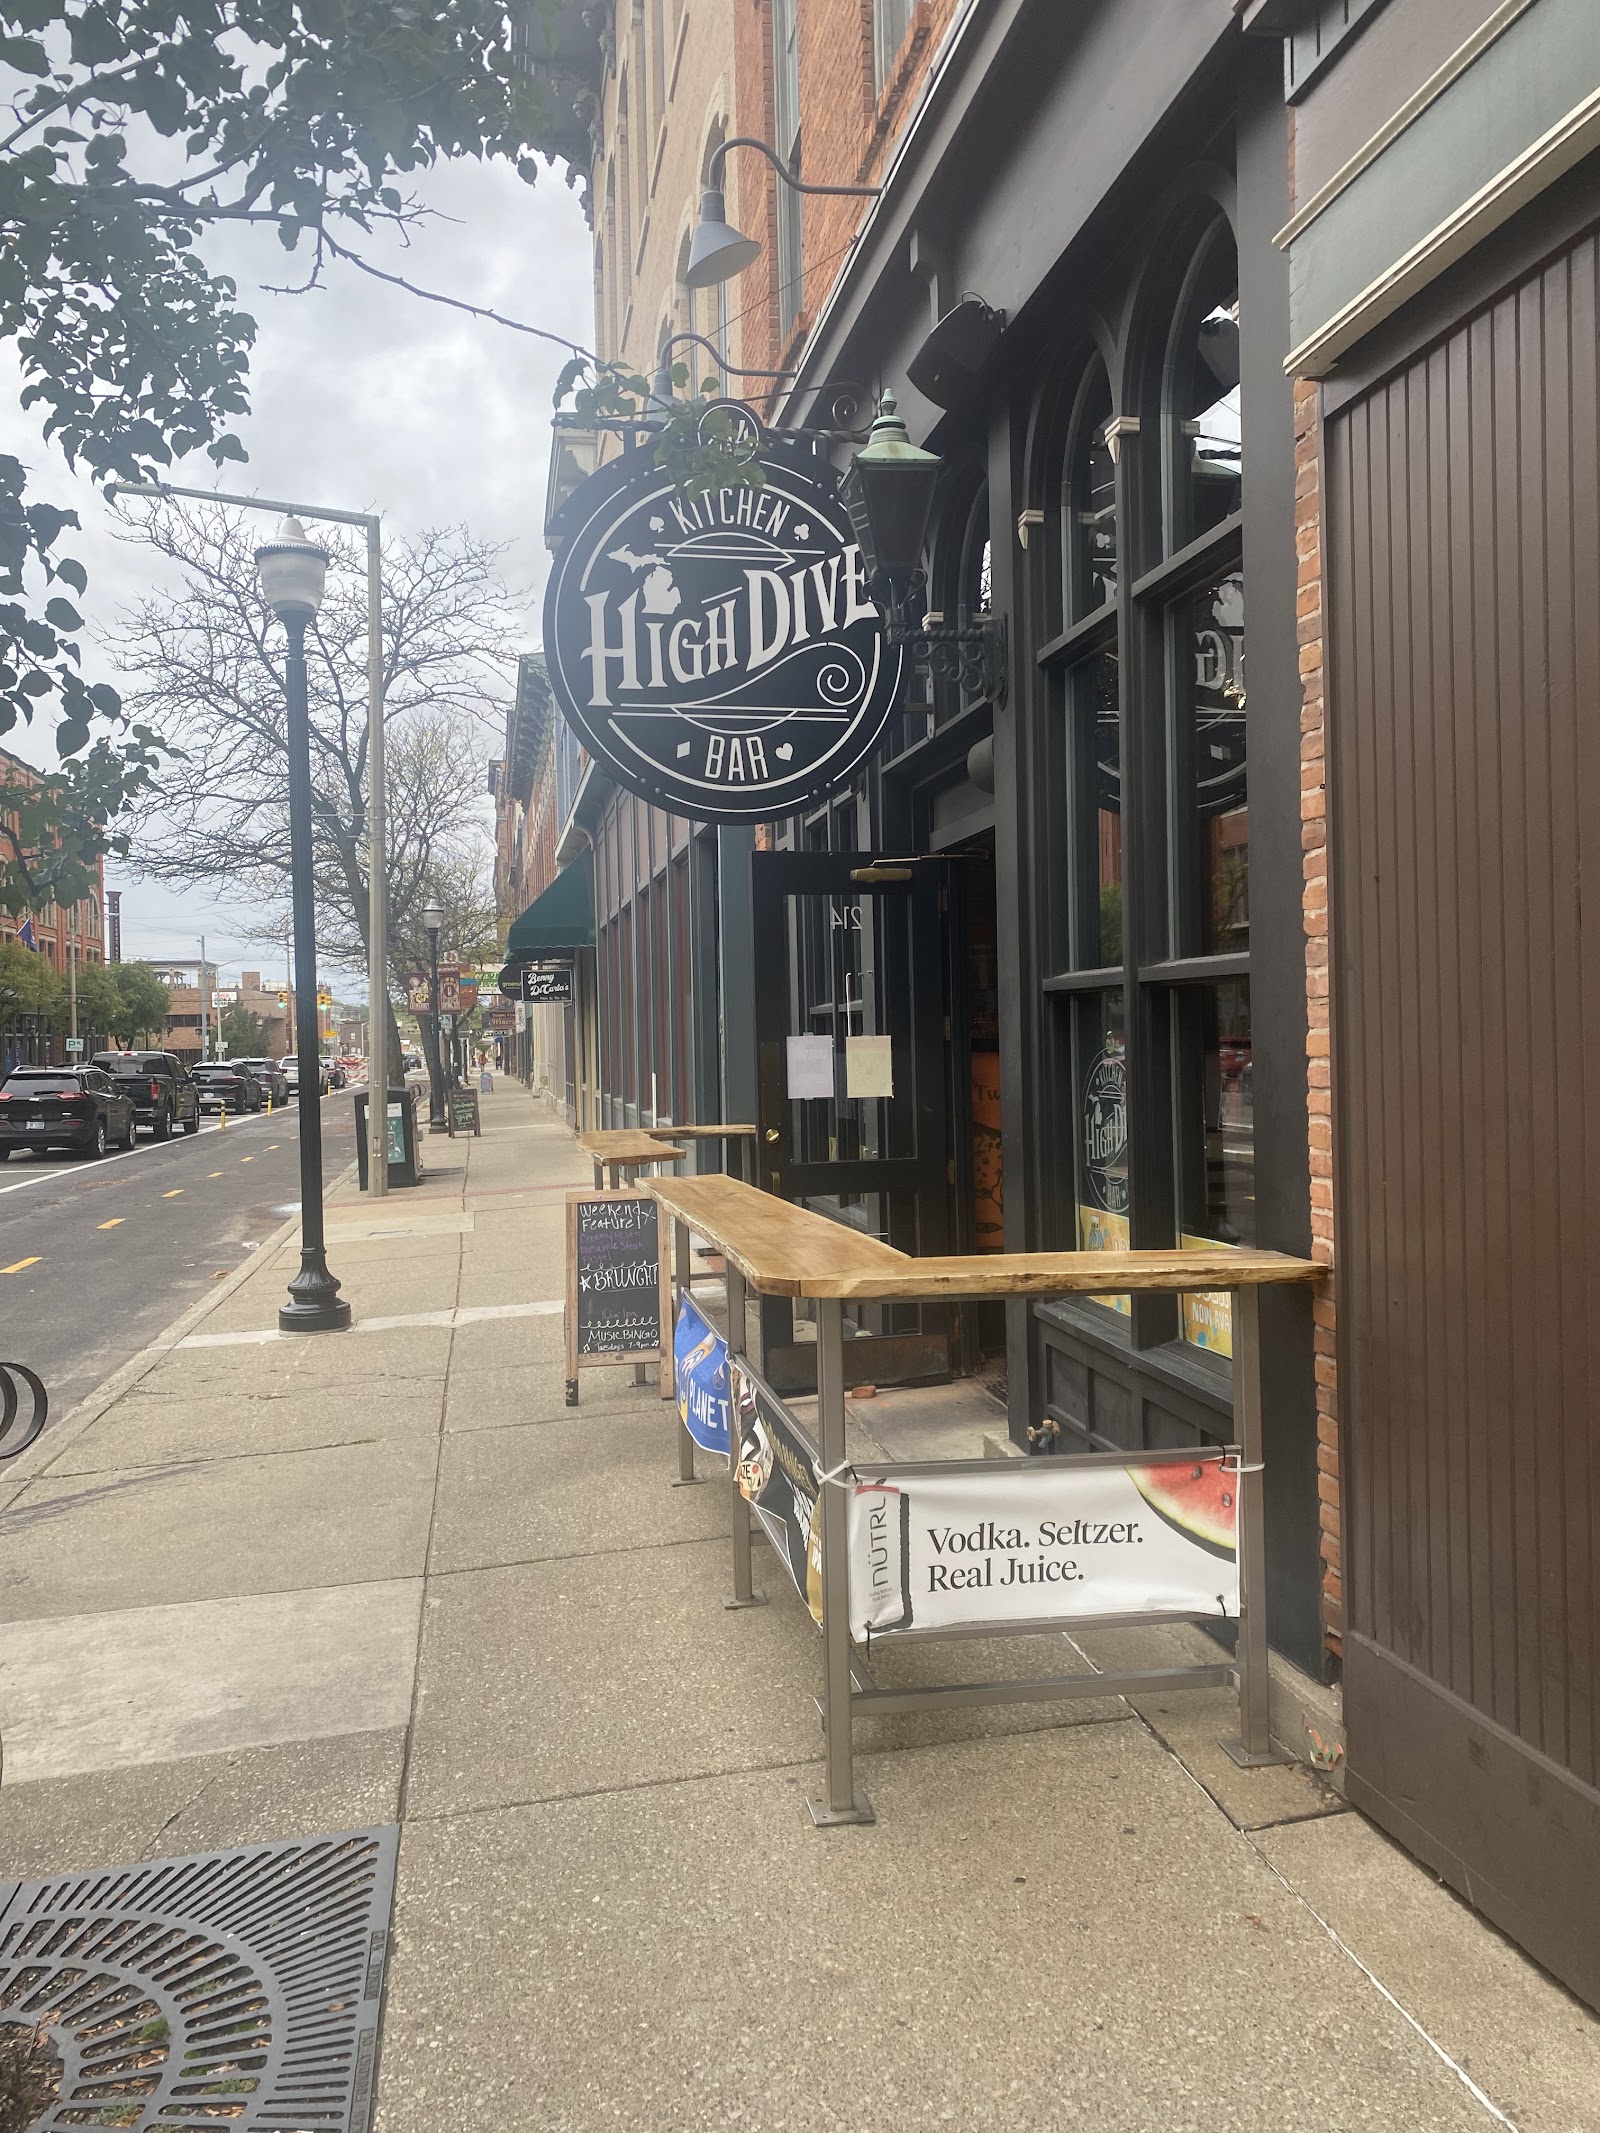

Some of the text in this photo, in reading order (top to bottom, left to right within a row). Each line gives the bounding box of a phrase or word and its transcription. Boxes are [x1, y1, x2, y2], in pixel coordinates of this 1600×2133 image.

[668, 487, 790, 538] KITCHEN
[580, 543, 880, 706] HIGH DIVE
[704, 734, 769, 781] BAR
[527, 973, 555, 985] Benny
[1099, 1064, 1123, 1088] KITCHEN
[580, 1200, 641, 1220] Weekend
[1107, 1185, 1122, 1208] BAR
[1192, 1301, 1213, 1328] NOW
[587, 1328, 658, 1342] MUSIC BINGO
[594, 1341, 625, 1352] Tuesdays
[689, 1377, 729, 1432] PLANET
[927, 1519, 1144, 1555] Vodka. Seltzer.
[927, 1555, 1085, 1593] Real Juice.
